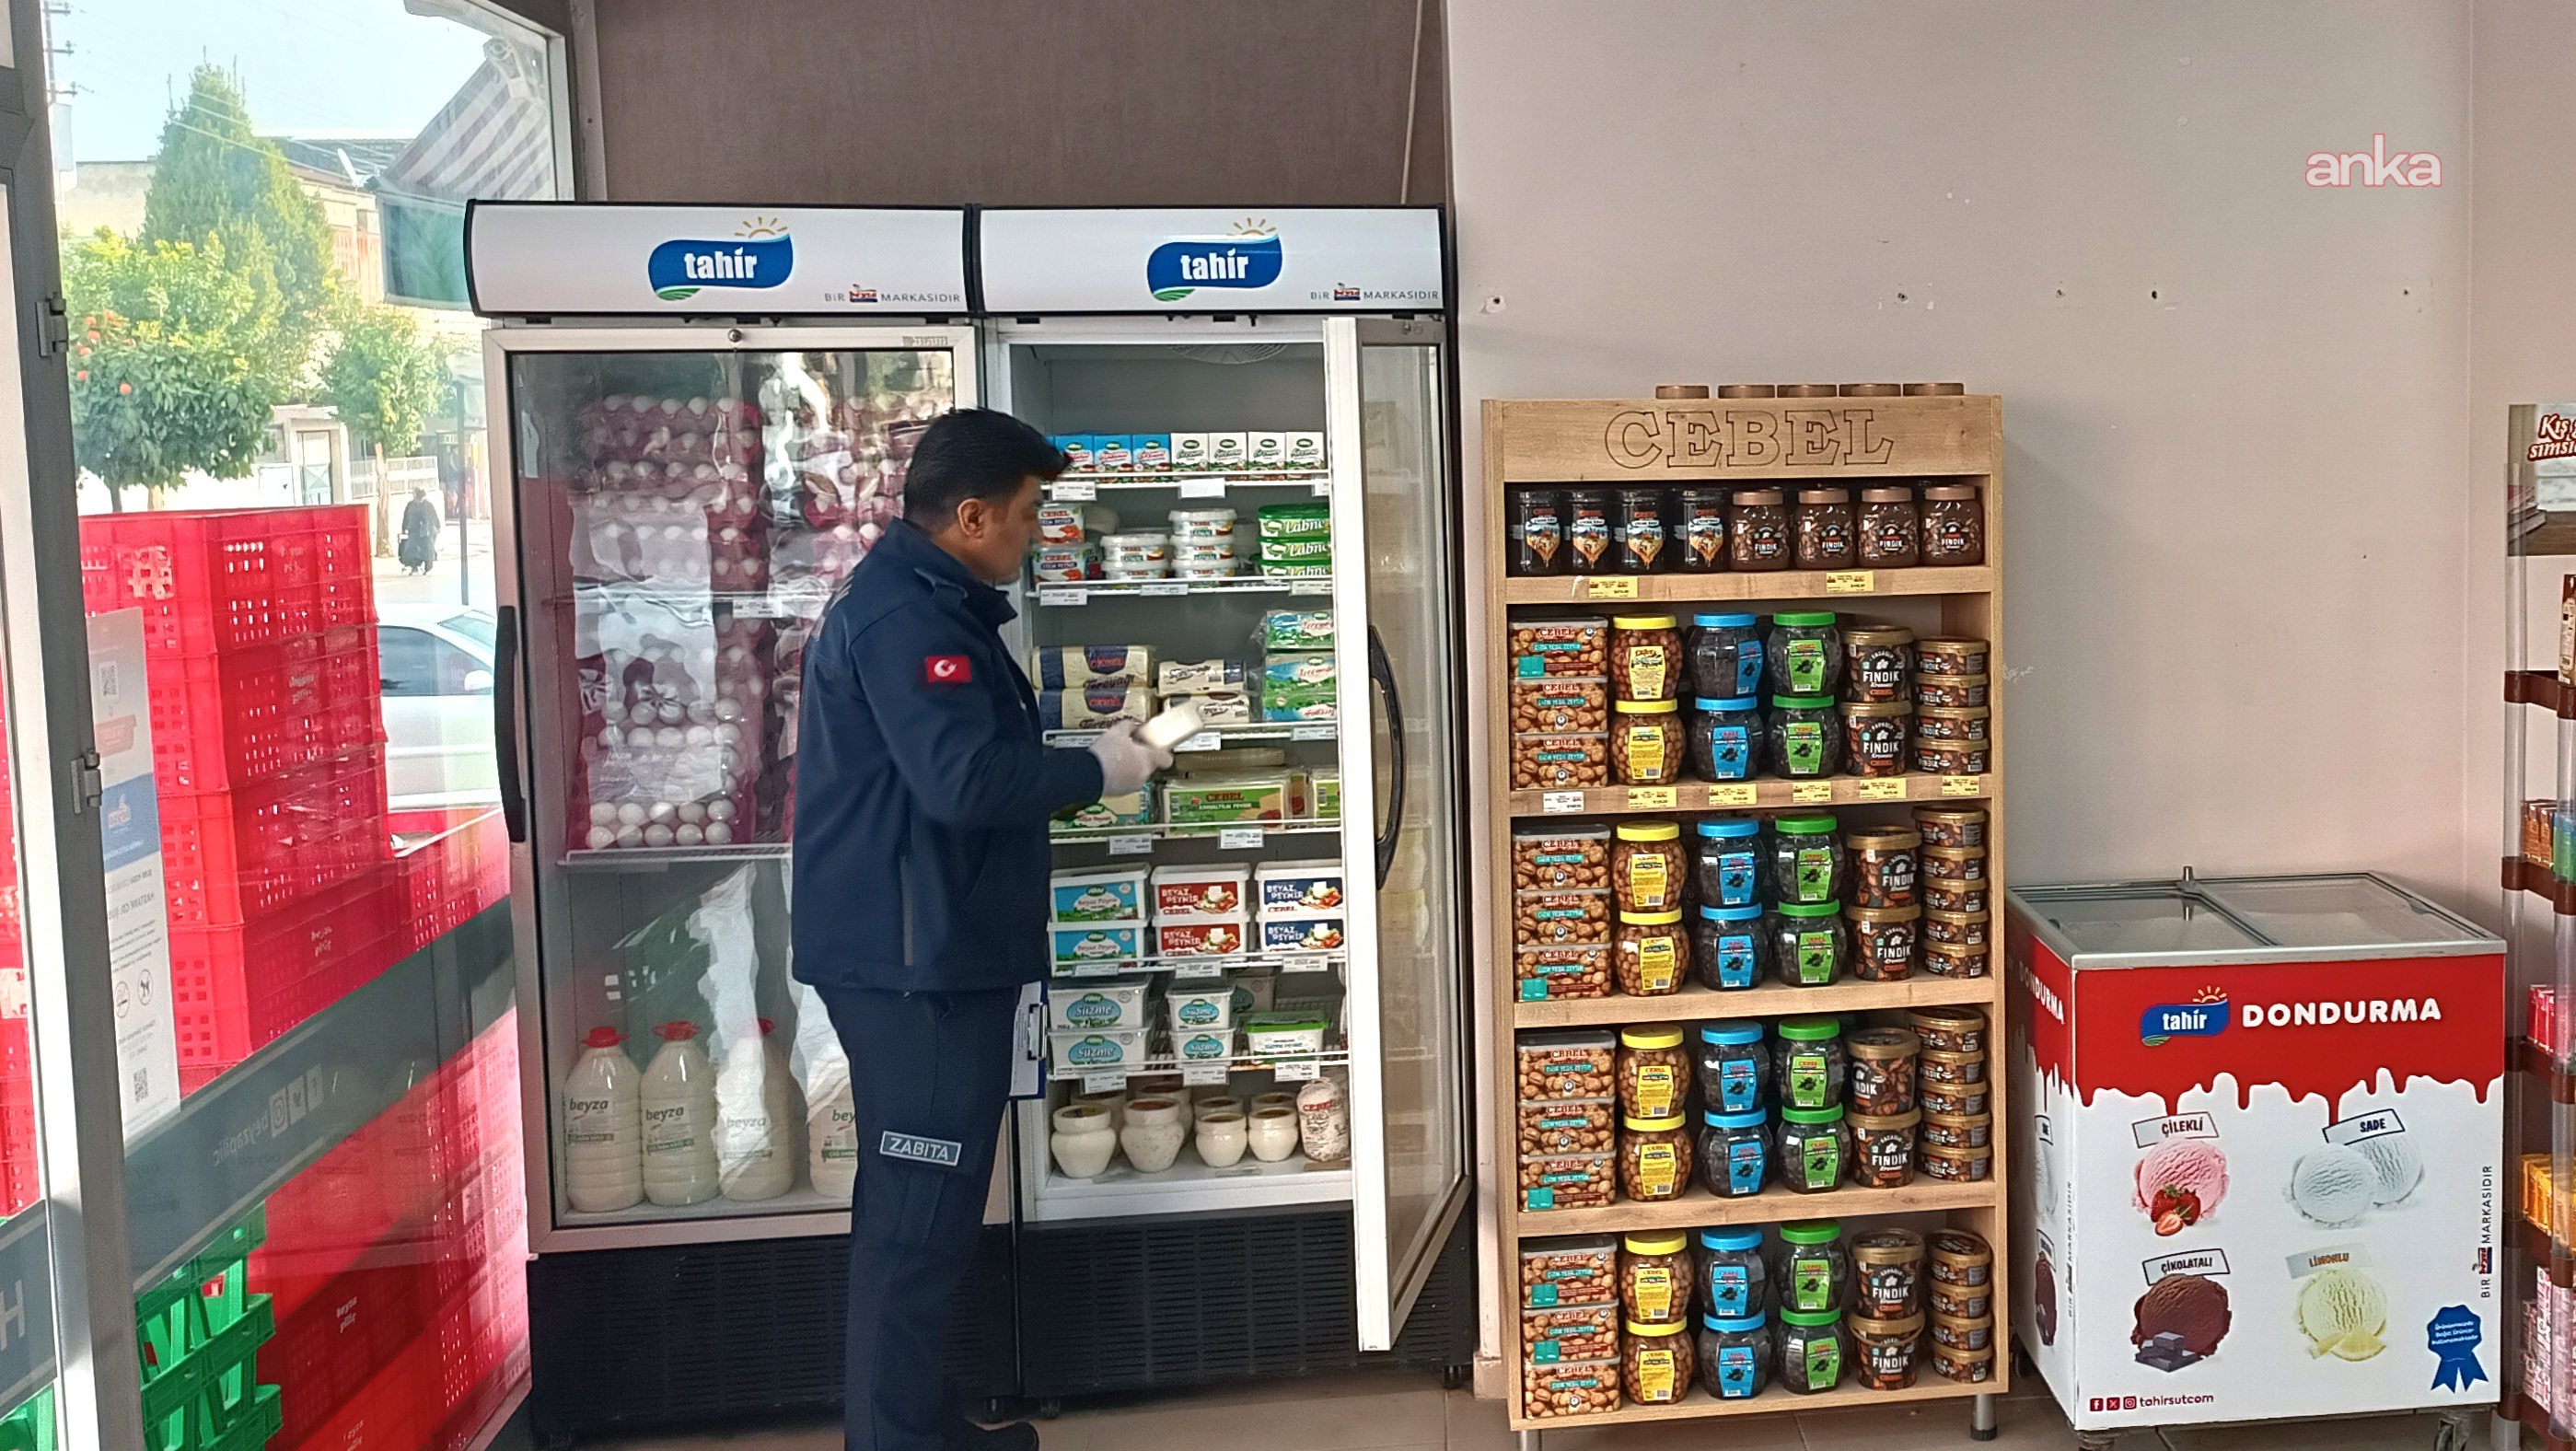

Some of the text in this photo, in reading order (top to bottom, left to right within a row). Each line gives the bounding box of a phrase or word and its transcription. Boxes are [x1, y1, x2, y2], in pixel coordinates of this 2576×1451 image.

[684, 246, 757, 280] tahir
[1180, 248, 1248, 281] tahir
[1605, 409, 1894, 469] CEBEL
[1862, 670, 1900, 682] FINDIK
[1862, 741, 1899, 753] FINDIK
[1882, 874, 1914, 886] FINDIK
[1876, 946, 1911, 959] FINDIK
[2163, 1008, 2208, 1031] tahir
[2242, 998, 2443, 1028] DONDURMA
[1853, 1082, 1877, 1096] NDIK
[569, 1097, 609, 1112] beyza
[645, 1106, 685, 1121] beyza
[831, 1109, 856, 1124] bey
[726, 1116, 767, 1131] beyza
[2162, 1119, 2204, 1137] ÇİLEKLİ
[2360, 1118, 2386, 1133] SADE
[889, 1137, 949, 1161] ZABITA
[1872, 1152, 1908, 1167] FINDIK
[2161, 1256, 2213, 1274] ÇİKOLATALI
[1872, 1286, 1909, 1299] FINDIK
[1872, 1355, 1909, 1368] FINDIK
[2140, 1393, 2214, 1407] tahirsutcom
